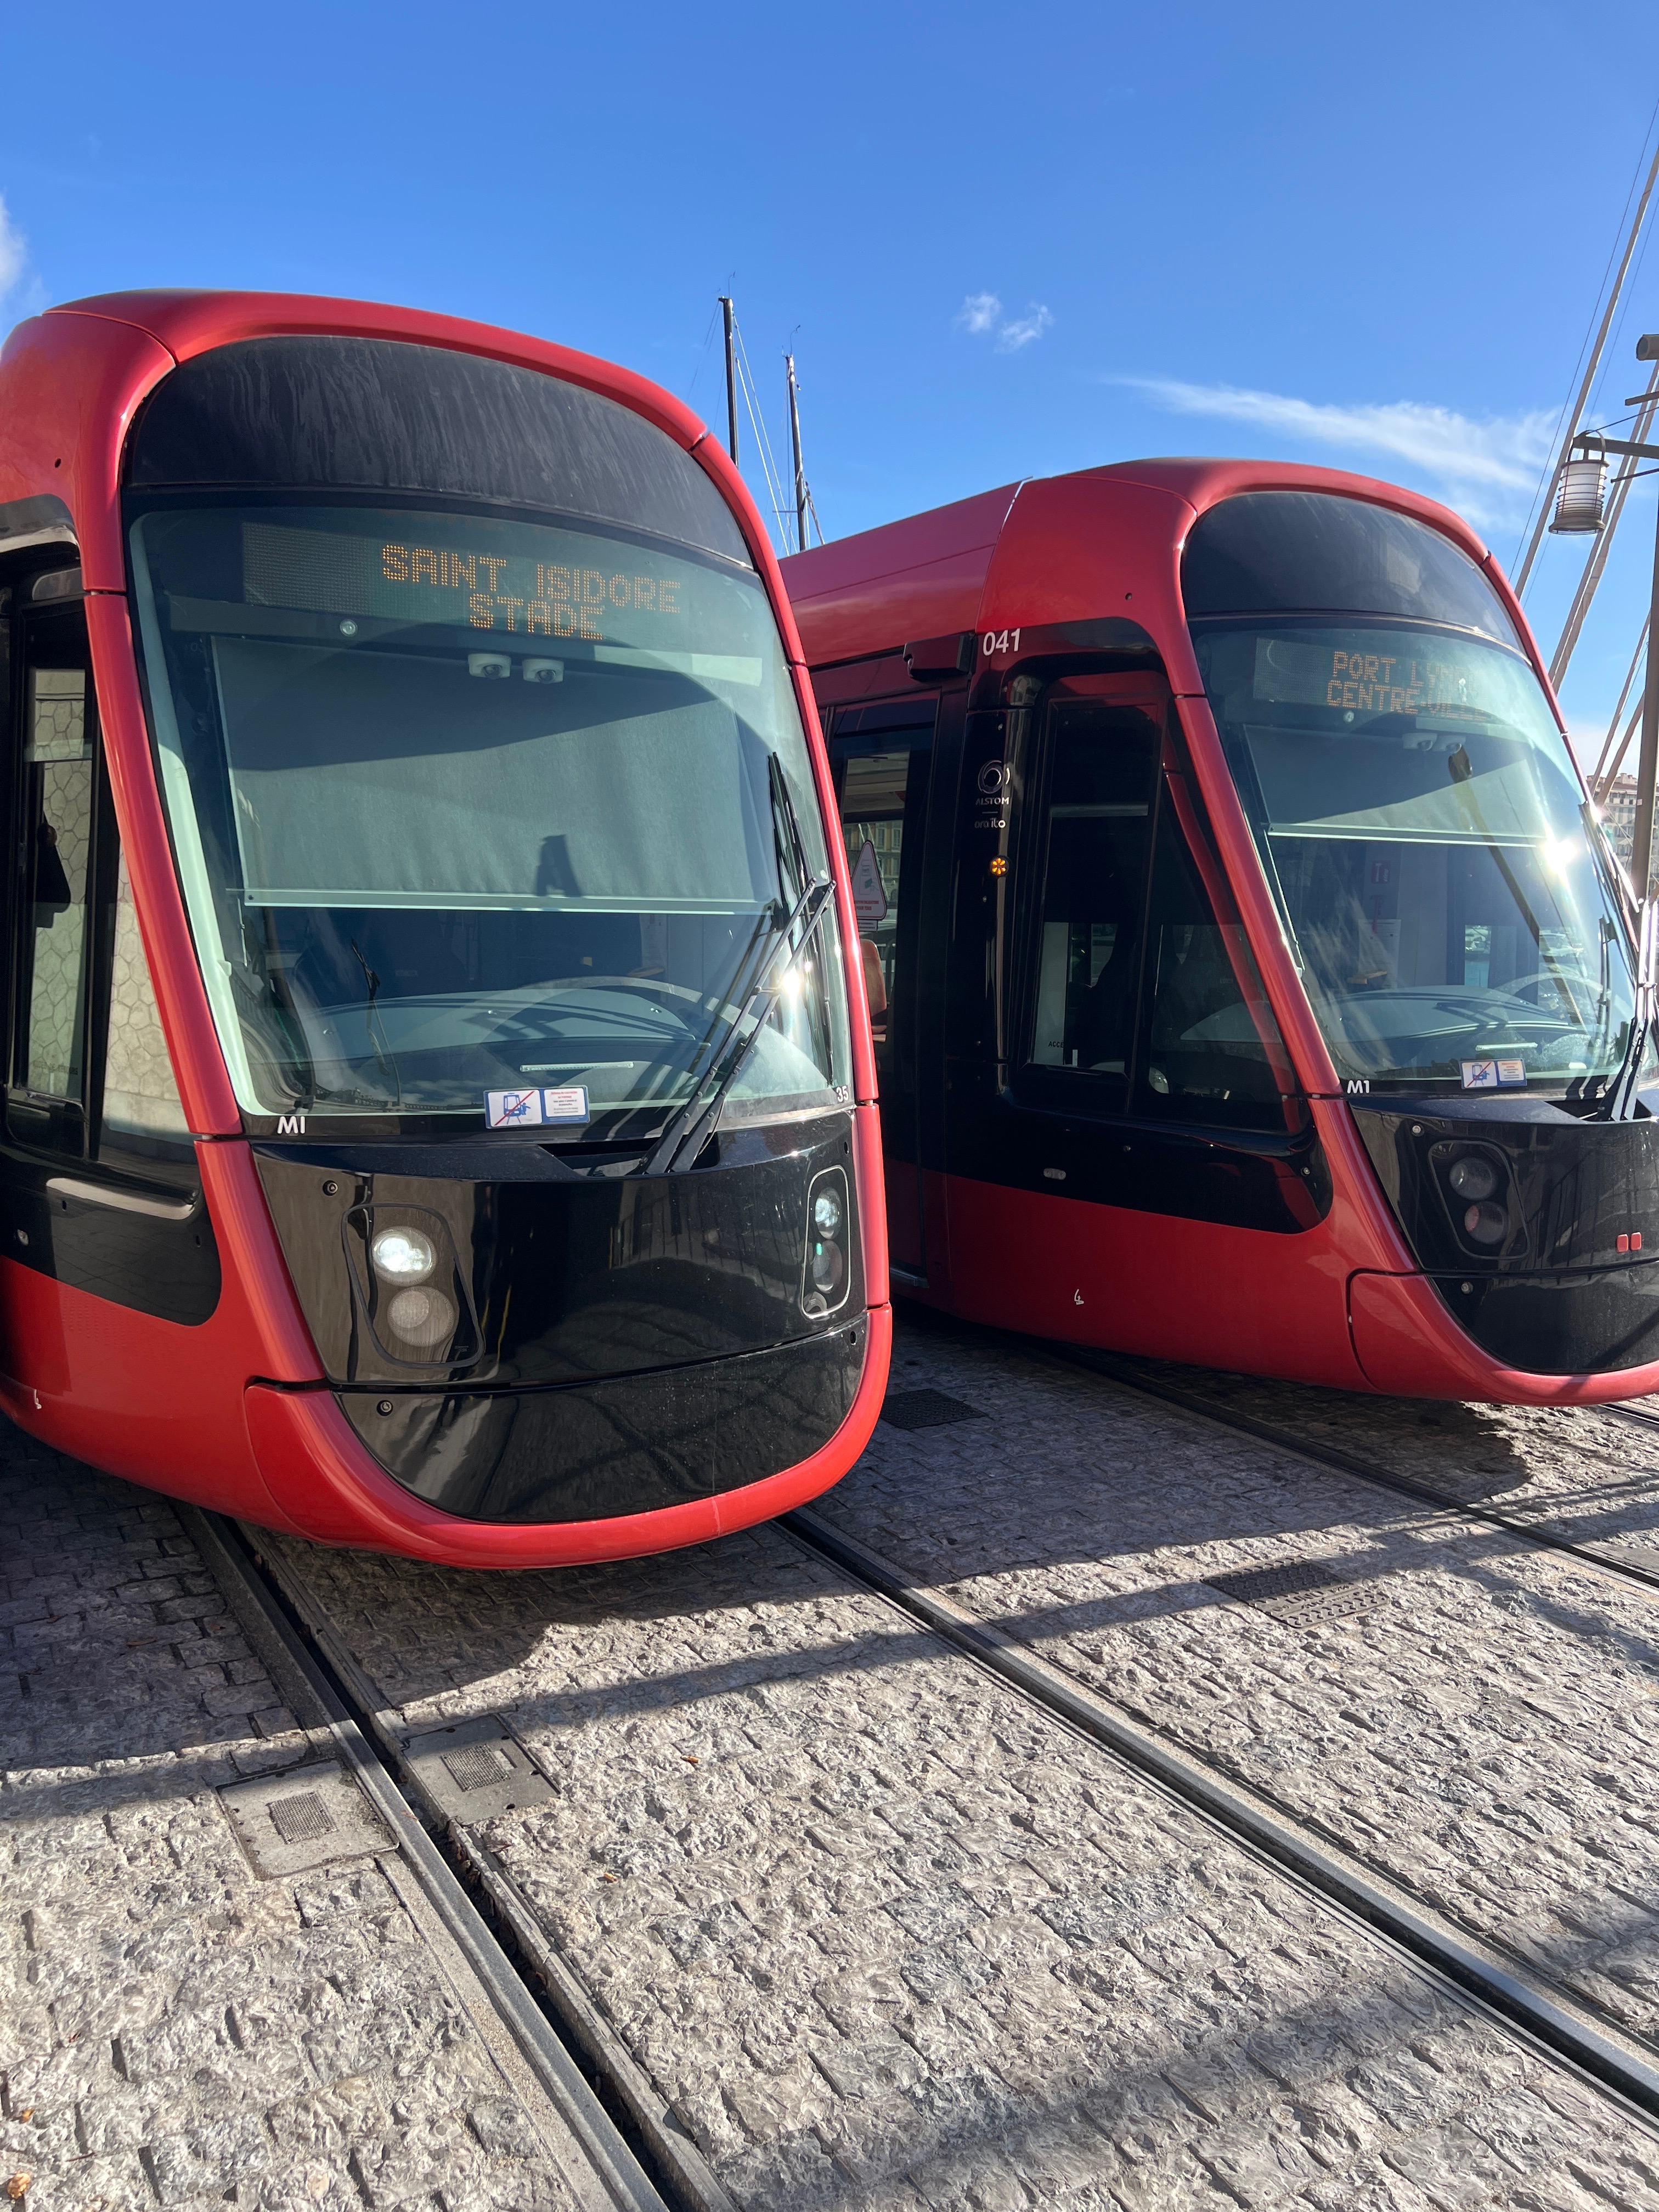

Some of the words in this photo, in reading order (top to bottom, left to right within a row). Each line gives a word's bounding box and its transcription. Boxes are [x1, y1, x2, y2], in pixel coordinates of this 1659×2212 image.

[382, 544, 507, 591] SAINT
[535, 563, 681, 614] ISIDORE
[469, 593, 604, 640] STADE
[983, 628, 1021, 656] 041
[1333, 651, 1397, 683] PORT
[975, 797, 1010, 806] ALSTOM
[1048, 1040, 1064, 1048] ACCÈ
[836, 1085, 849, 1103] 35
[1346, 1080, 1370, 1094] M1
